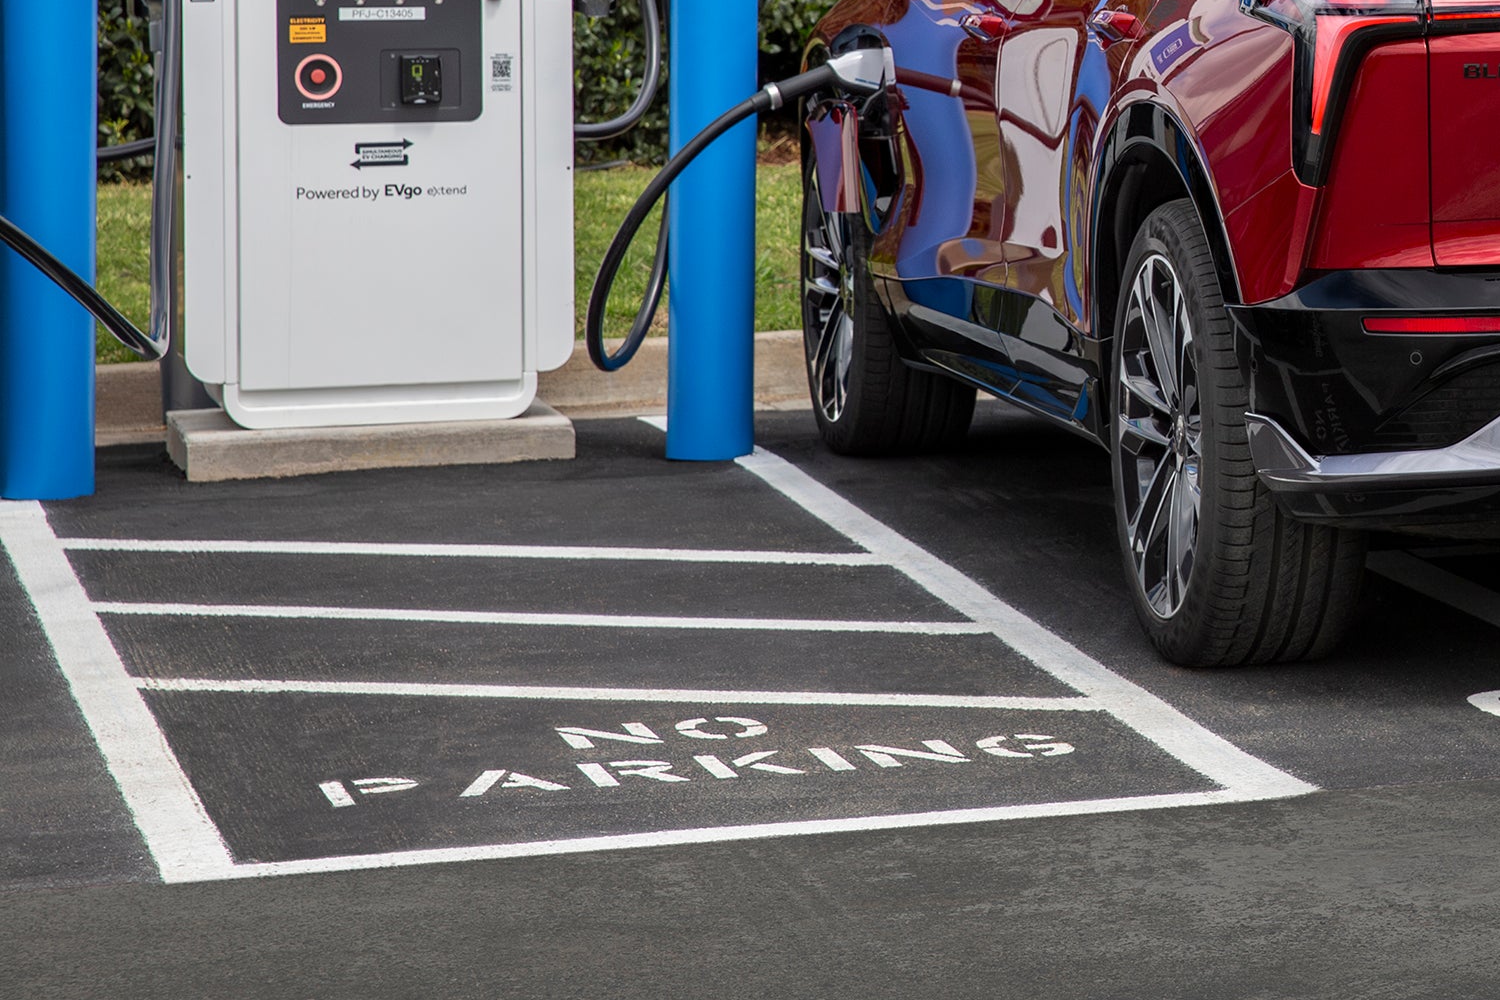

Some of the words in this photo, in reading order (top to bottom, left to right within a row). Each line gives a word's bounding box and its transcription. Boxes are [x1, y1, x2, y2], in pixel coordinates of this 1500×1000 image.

[296, 186, 359, 200] Powered
[362, 185, 380, 202] by
[385, 184, 422, 199] EVgo
[553, 716, 768, 750] NO
[316, 733, 1076, 809] PARKING
